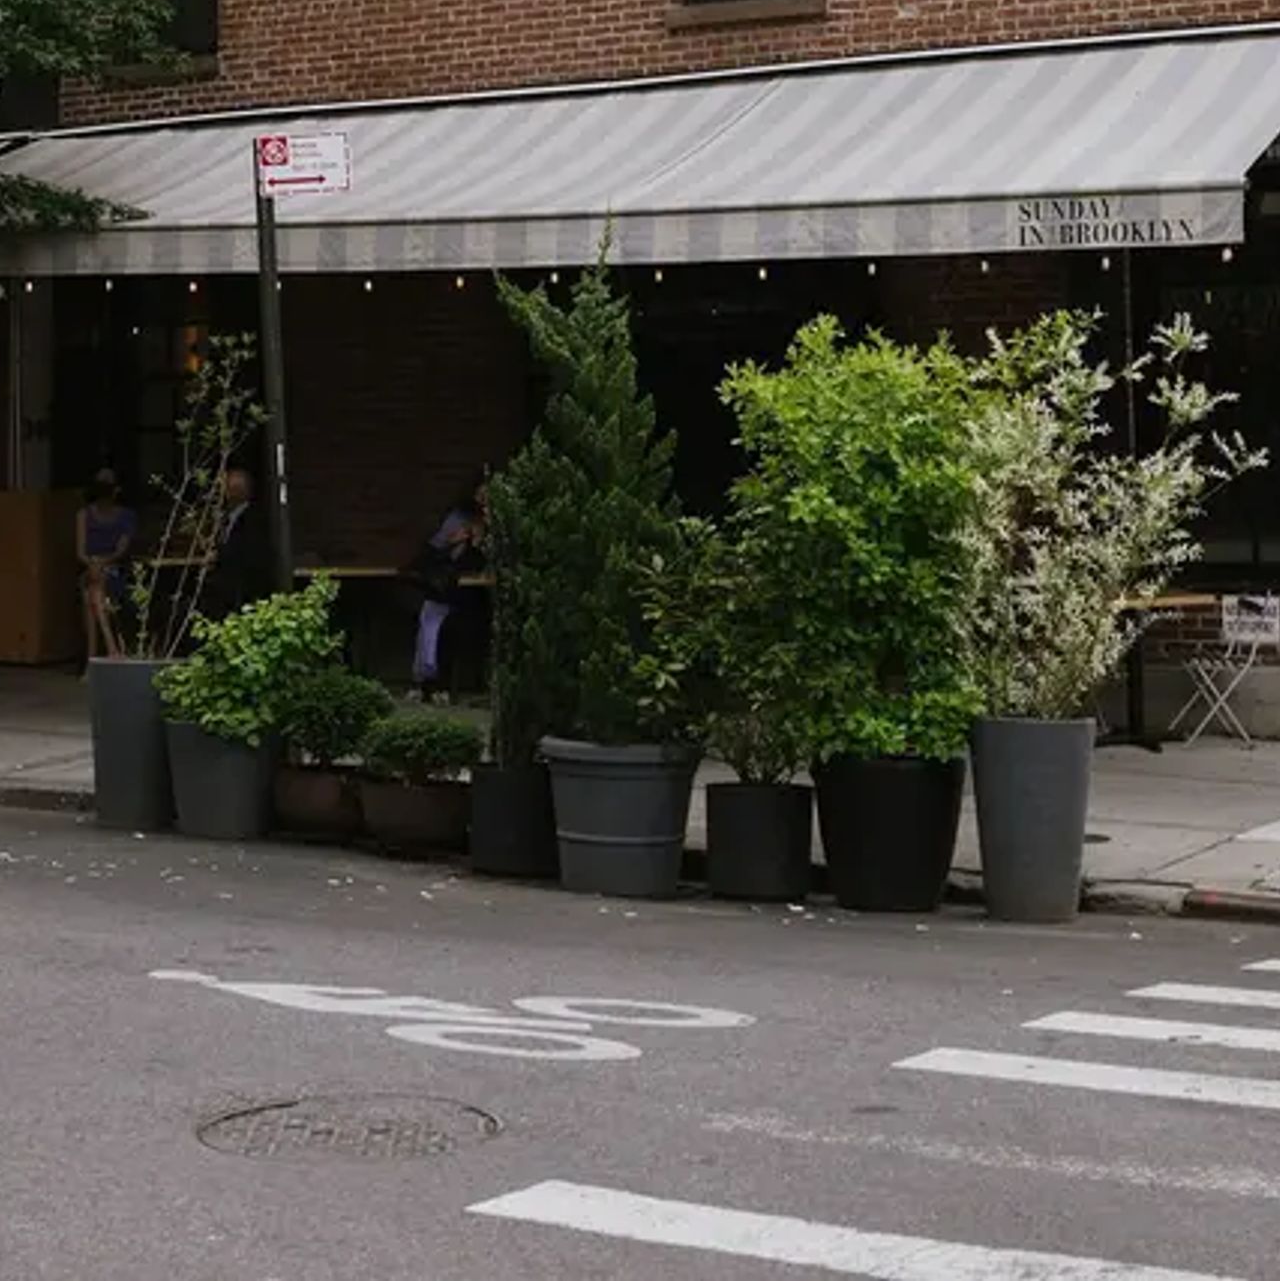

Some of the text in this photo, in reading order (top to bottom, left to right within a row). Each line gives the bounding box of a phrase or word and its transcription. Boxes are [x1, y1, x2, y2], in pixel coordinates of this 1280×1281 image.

[1018, 198, 1112, 222] SUNDAY
[1019, 219, 1195, 247] IN BROOKLYN
